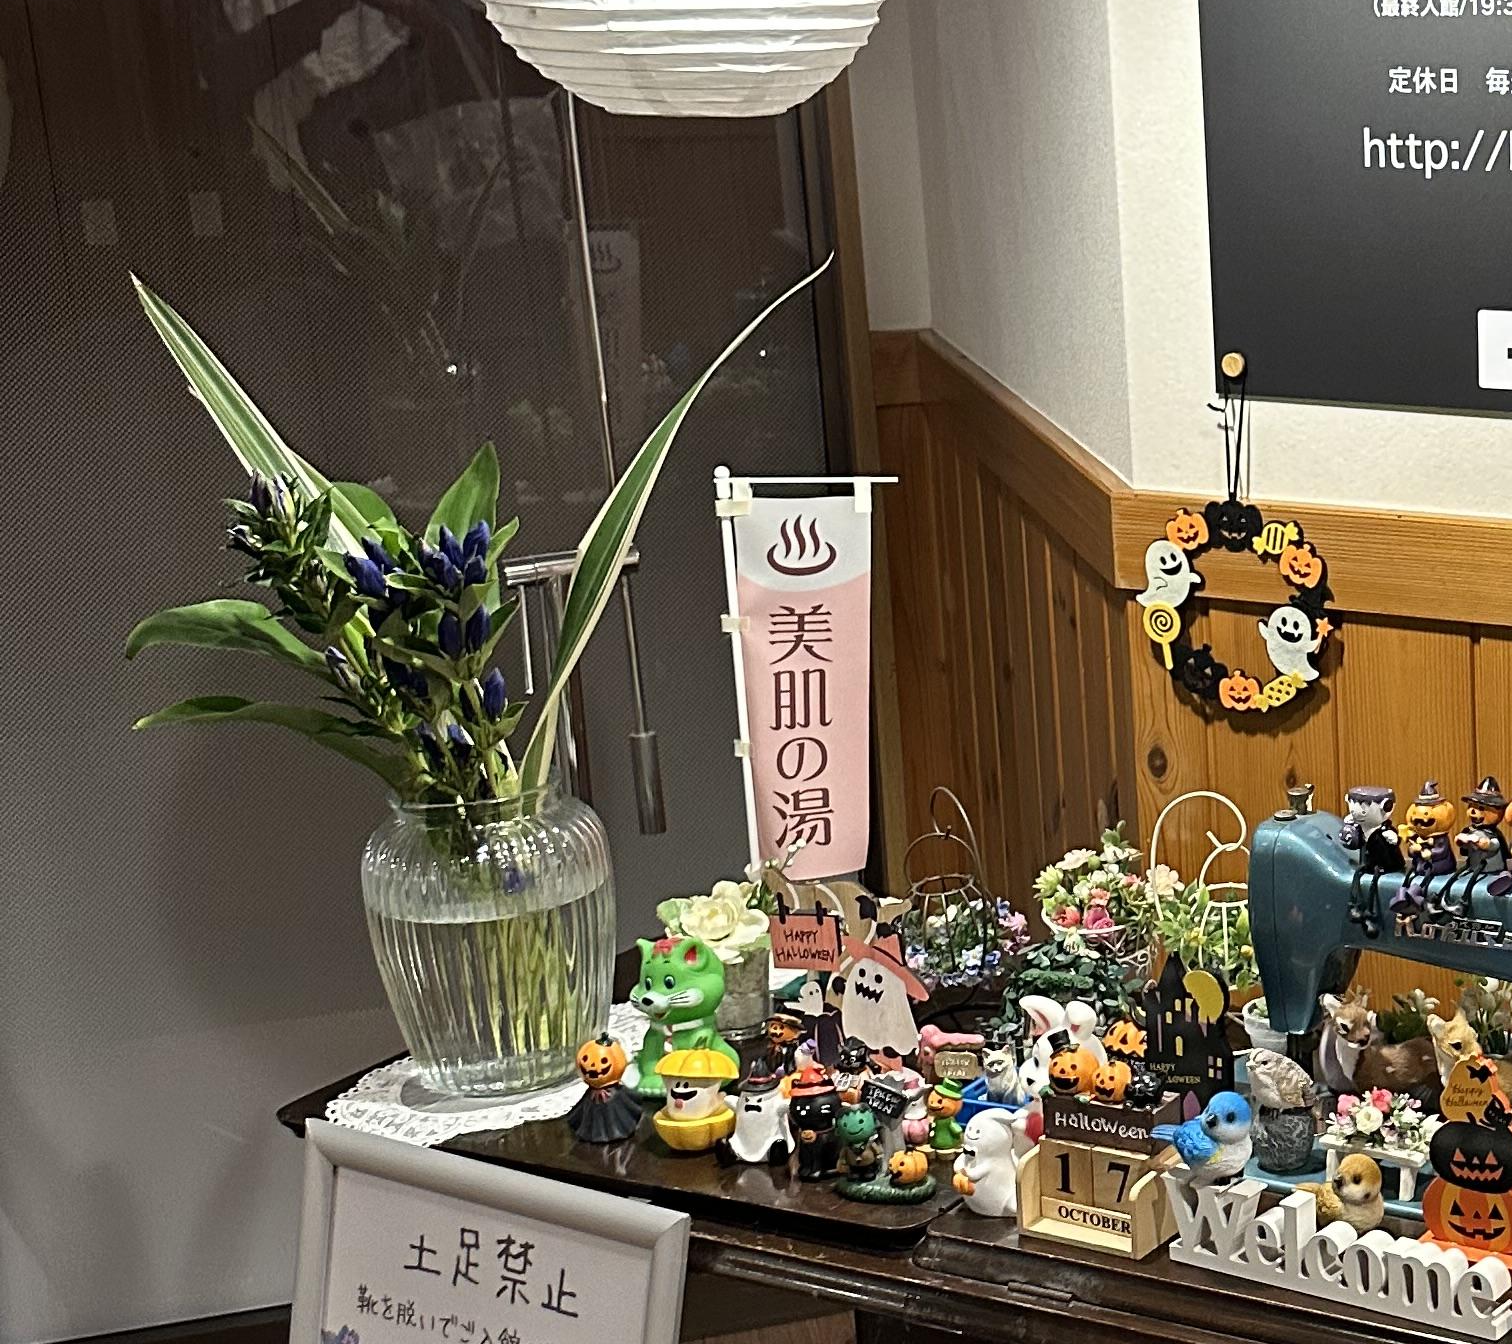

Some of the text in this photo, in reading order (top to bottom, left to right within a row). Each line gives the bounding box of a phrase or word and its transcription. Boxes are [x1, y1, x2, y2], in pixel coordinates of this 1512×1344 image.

[1388, 67, 1459, 94] 定休日
[768, 603, 834, 848] 美肌の湯
[784, 929, 819, 944] HAPPY
[776, 946, 835, 964] HALLOWEEN
[1055, 1112, 1149, 1140] Halloween
[1058, 1206, 1131, 1234] OCTOBER
[1161, 1169, 1510, 1320] Welcome
[404, 1227, 579, 1318] 土足禁止
